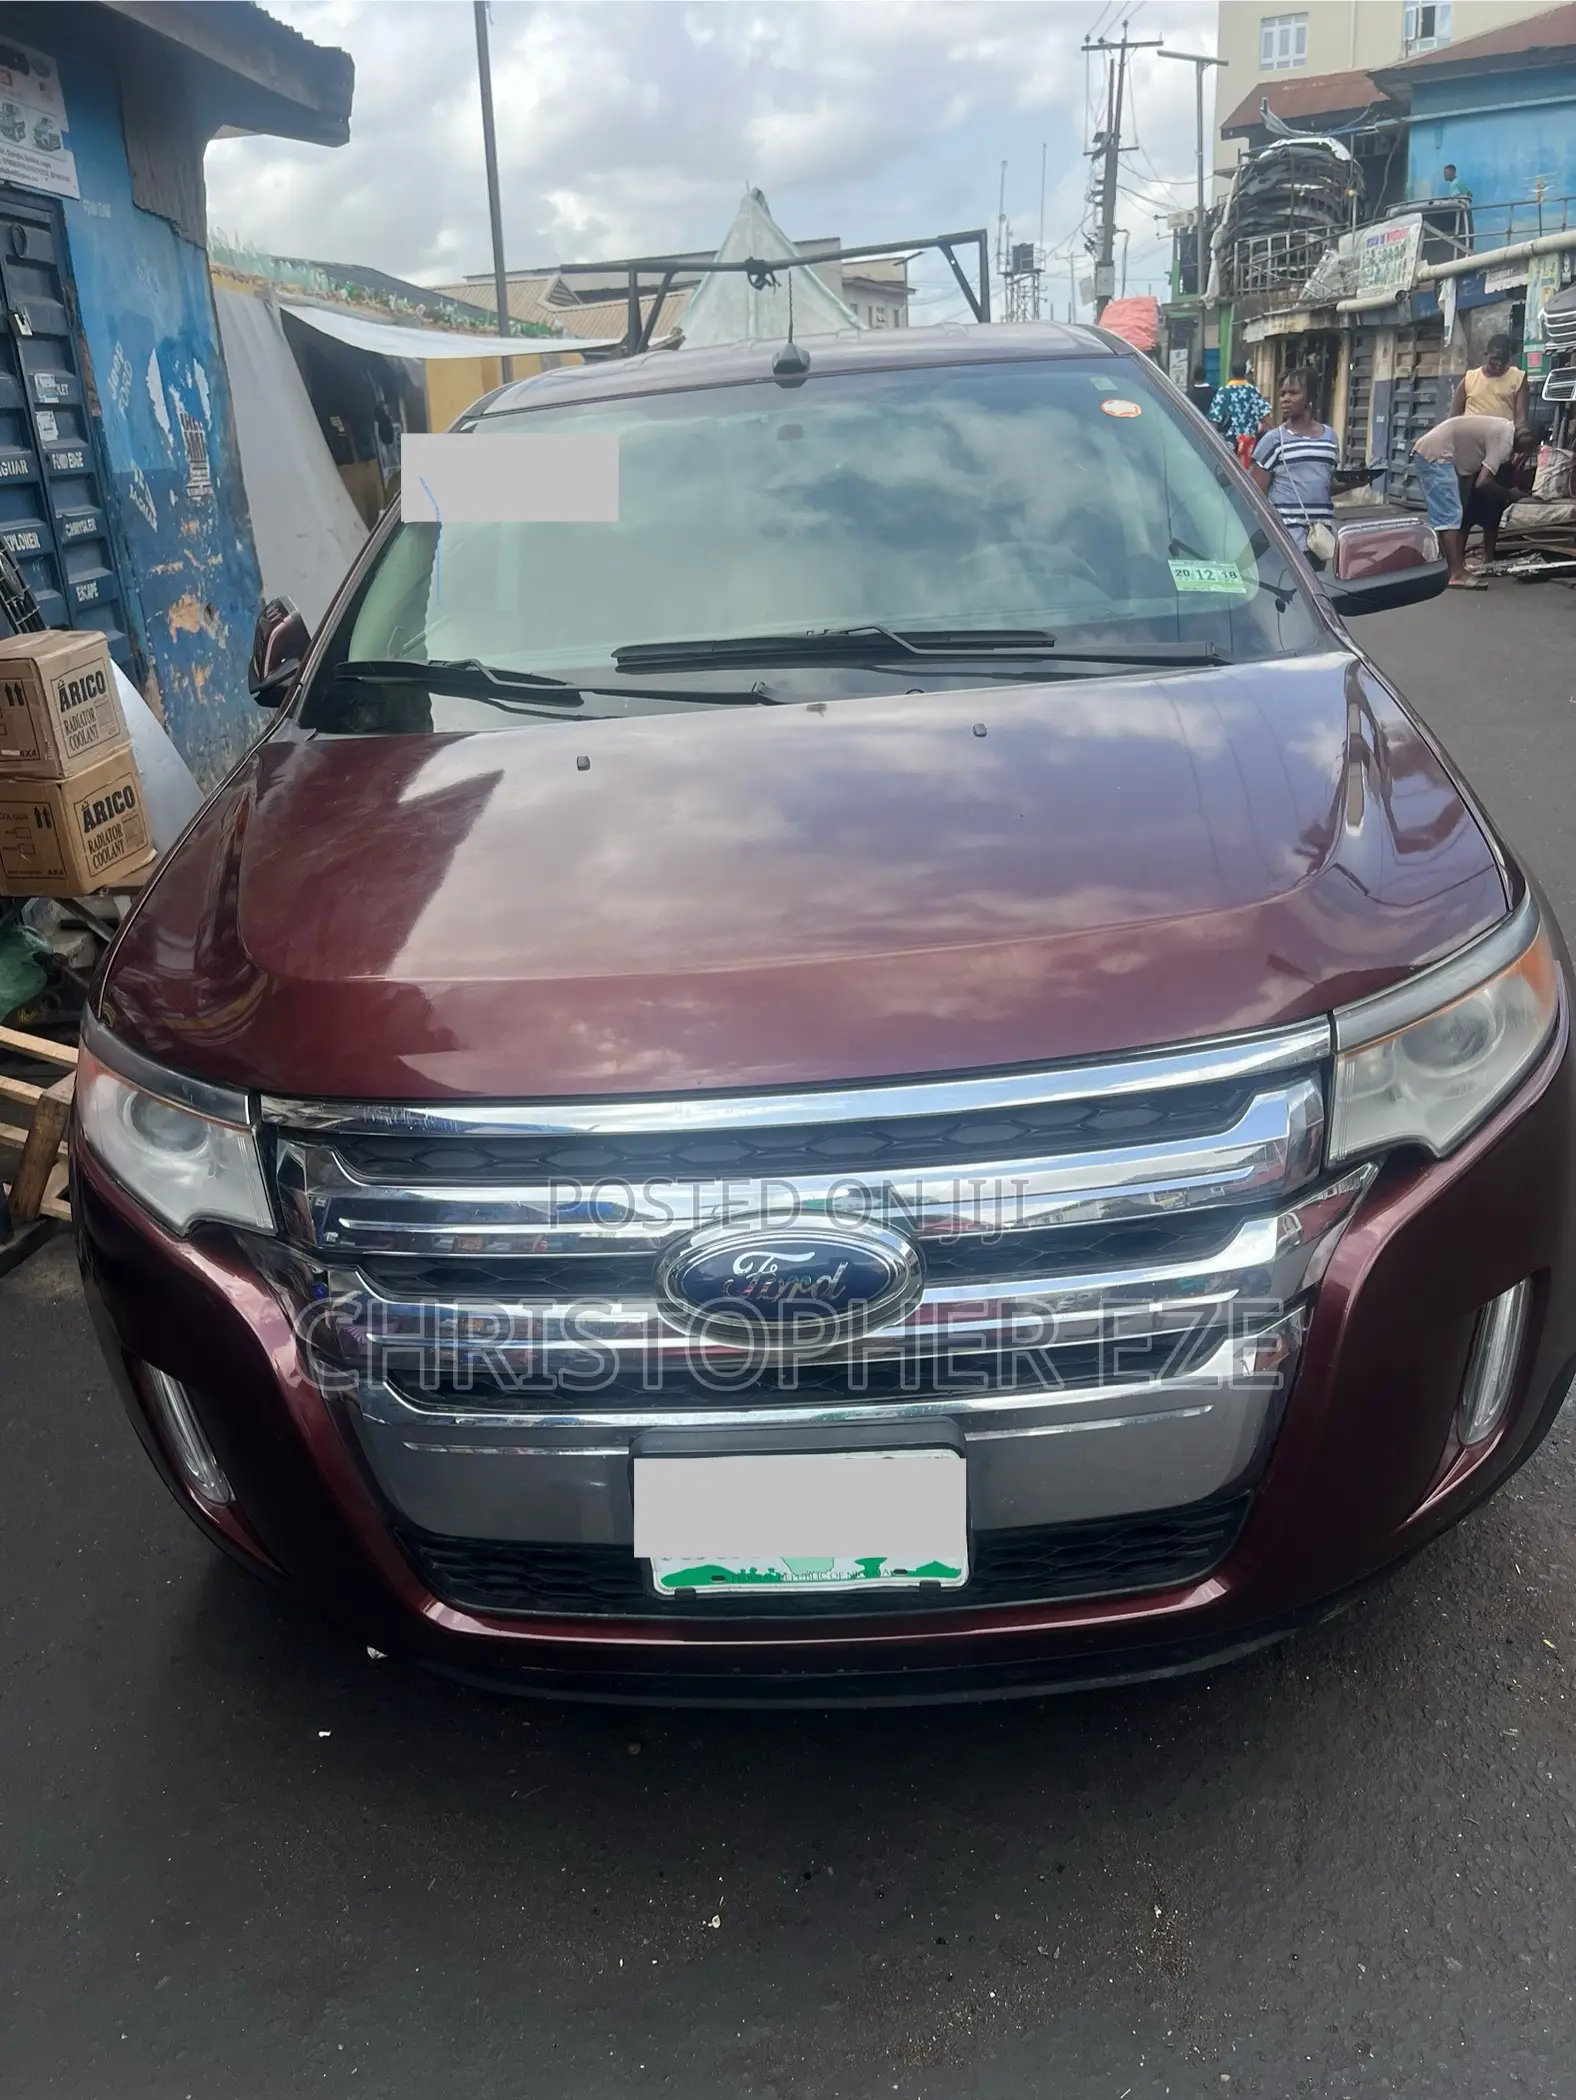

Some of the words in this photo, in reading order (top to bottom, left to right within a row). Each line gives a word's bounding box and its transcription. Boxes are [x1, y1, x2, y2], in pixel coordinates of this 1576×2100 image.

[1175, 569, 1190, 577] 20
[1195, 569, 1216, 581] 12
[64, 707, 97, 735] RADIATOR
[69, 724, 100, 751] COOLANT
[88, 823, 124, 854] RADIATOR
[92, 839, 126, 870] COOLANT
[723, 1251, 849, 1302] Ford
